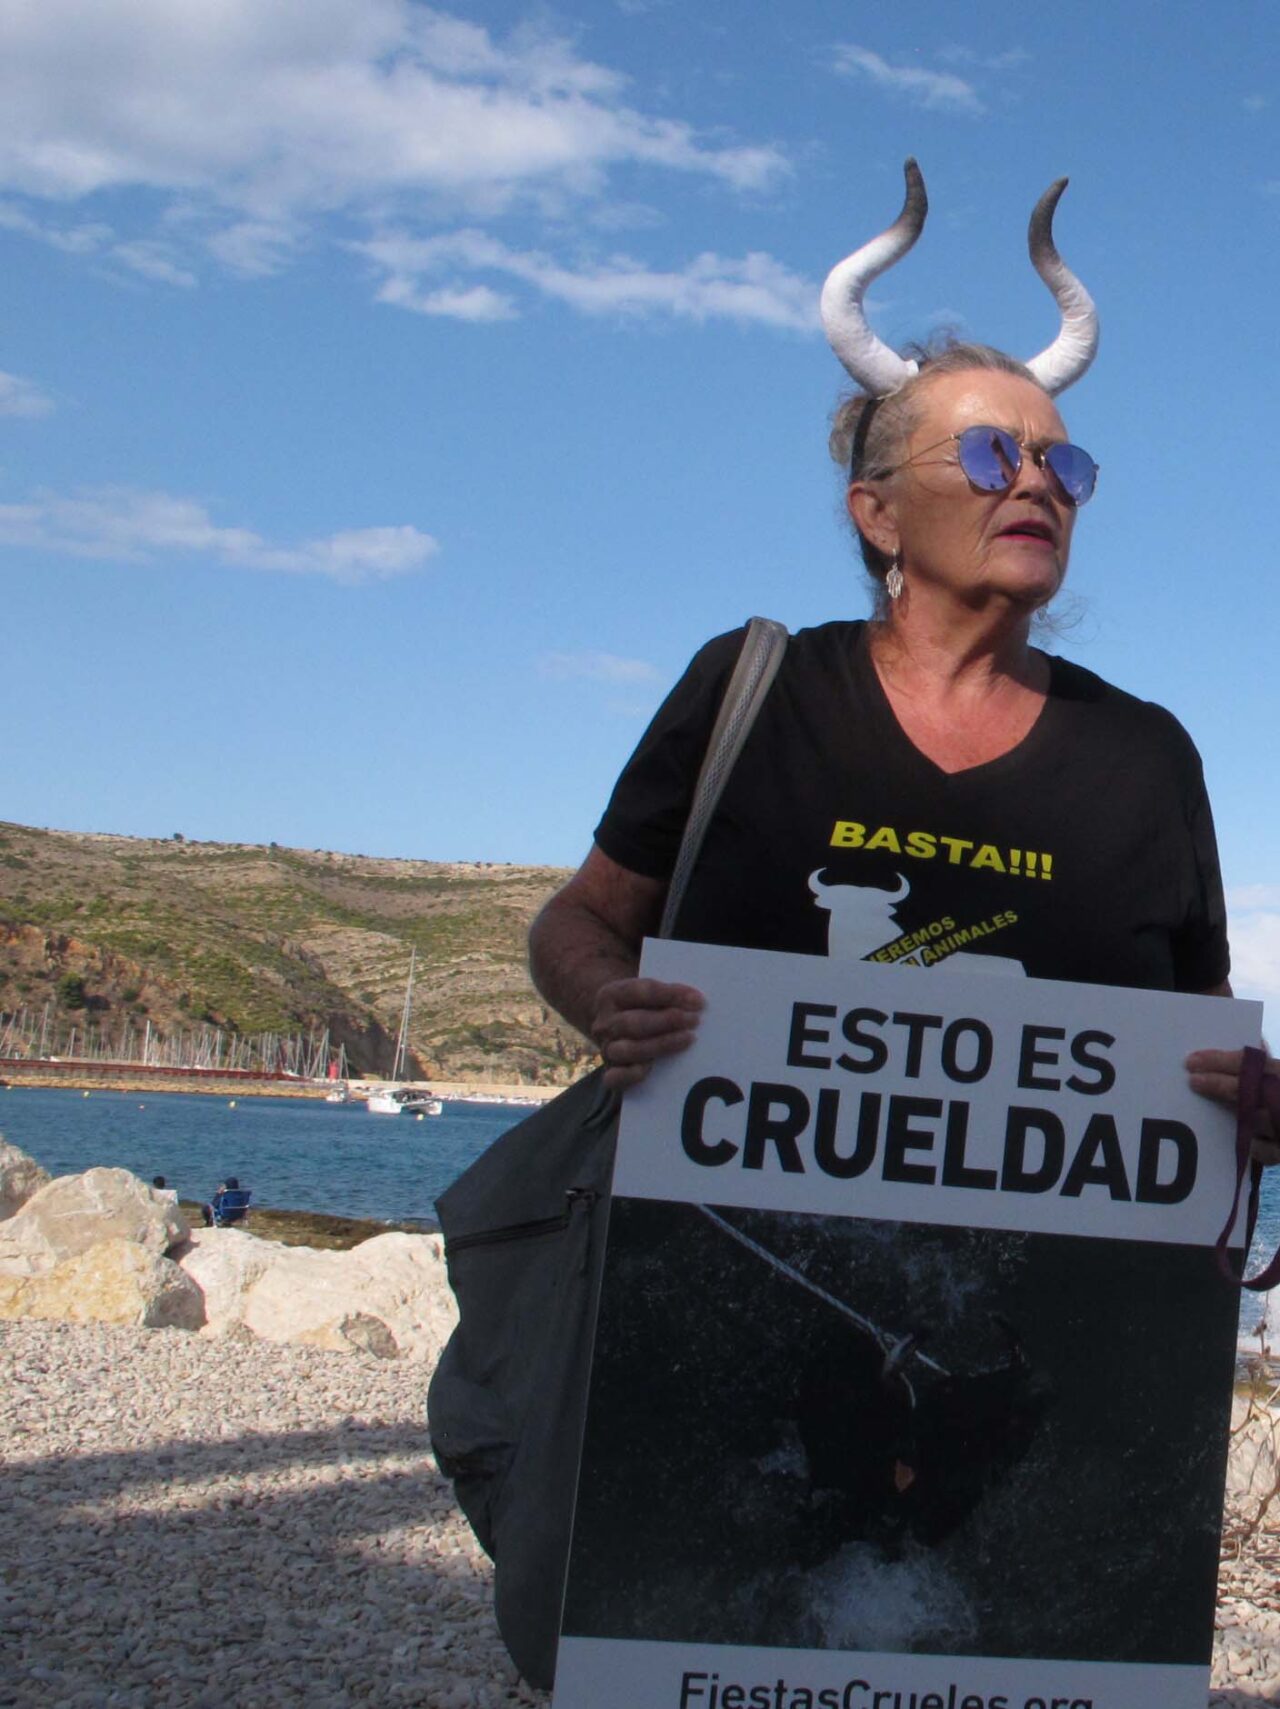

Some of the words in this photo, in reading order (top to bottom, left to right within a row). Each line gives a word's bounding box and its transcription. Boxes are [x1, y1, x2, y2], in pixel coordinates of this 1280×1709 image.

[830, 821, 1052, 880] BASTA!!!
[870, 916, 955, 963] EREMOS
[922, 910, 1018, 963] ANIMALES
[786, 1001, 993, 1084] ESTO
[1017, 1024, 1116, 1095] ES
[681, 1076, 1198, 1204] CRUELDAD
[680, 1672, 1093, 1709] FiestasCruele
